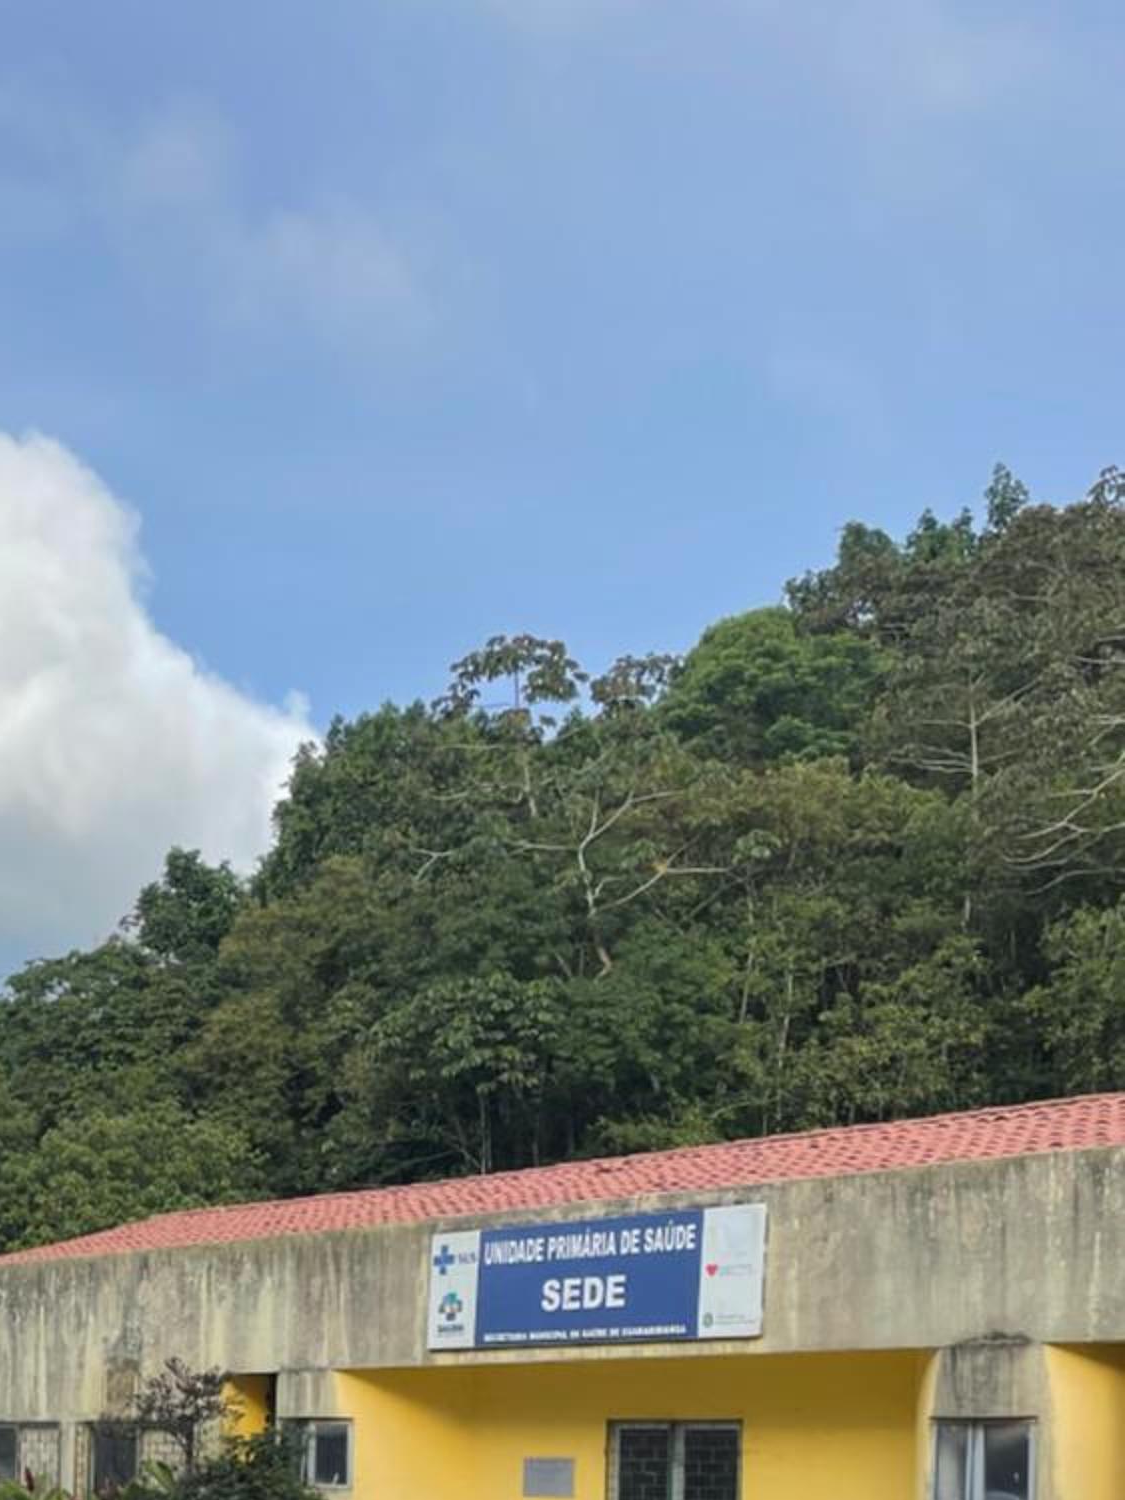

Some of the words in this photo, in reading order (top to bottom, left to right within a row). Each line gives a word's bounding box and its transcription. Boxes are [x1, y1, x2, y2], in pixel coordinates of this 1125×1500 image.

[484, 1237, 544, 1265] UNIDADE
[547, 1228, 616, 1261] PRIMÁRIA
[620, 1228, 641, 1255] DE
[644, 1220, 697, 1251] SAÚDE
[541, 1274, 627, 1312] SEDE
